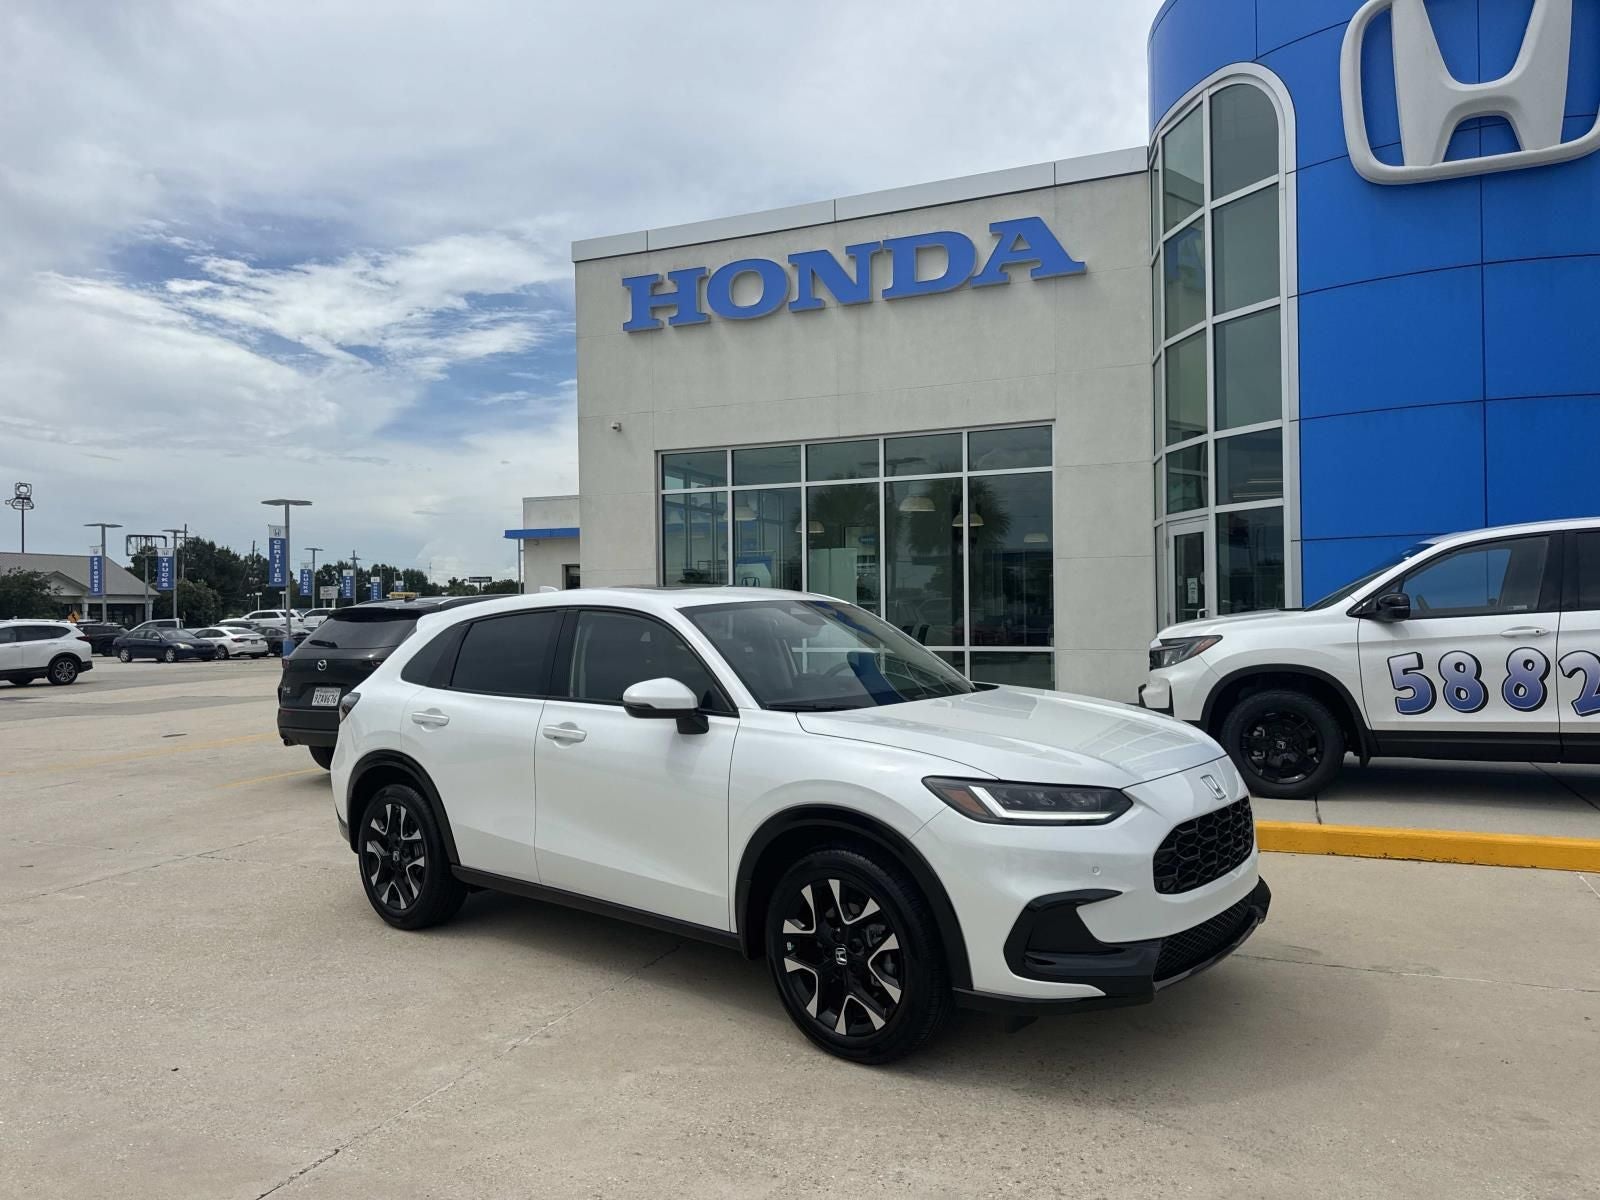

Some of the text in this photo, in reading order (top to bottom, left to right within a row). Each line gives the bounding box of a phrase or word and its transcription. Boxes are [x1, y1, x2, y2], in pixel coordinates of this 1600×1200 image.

[622, 216, 1087, 332] HONDA
[161, 557, 169, 588] TRUCKS
[273, 540, 281, 583] CERTIFIED
[1387, 647, 1600, 717] 5882
